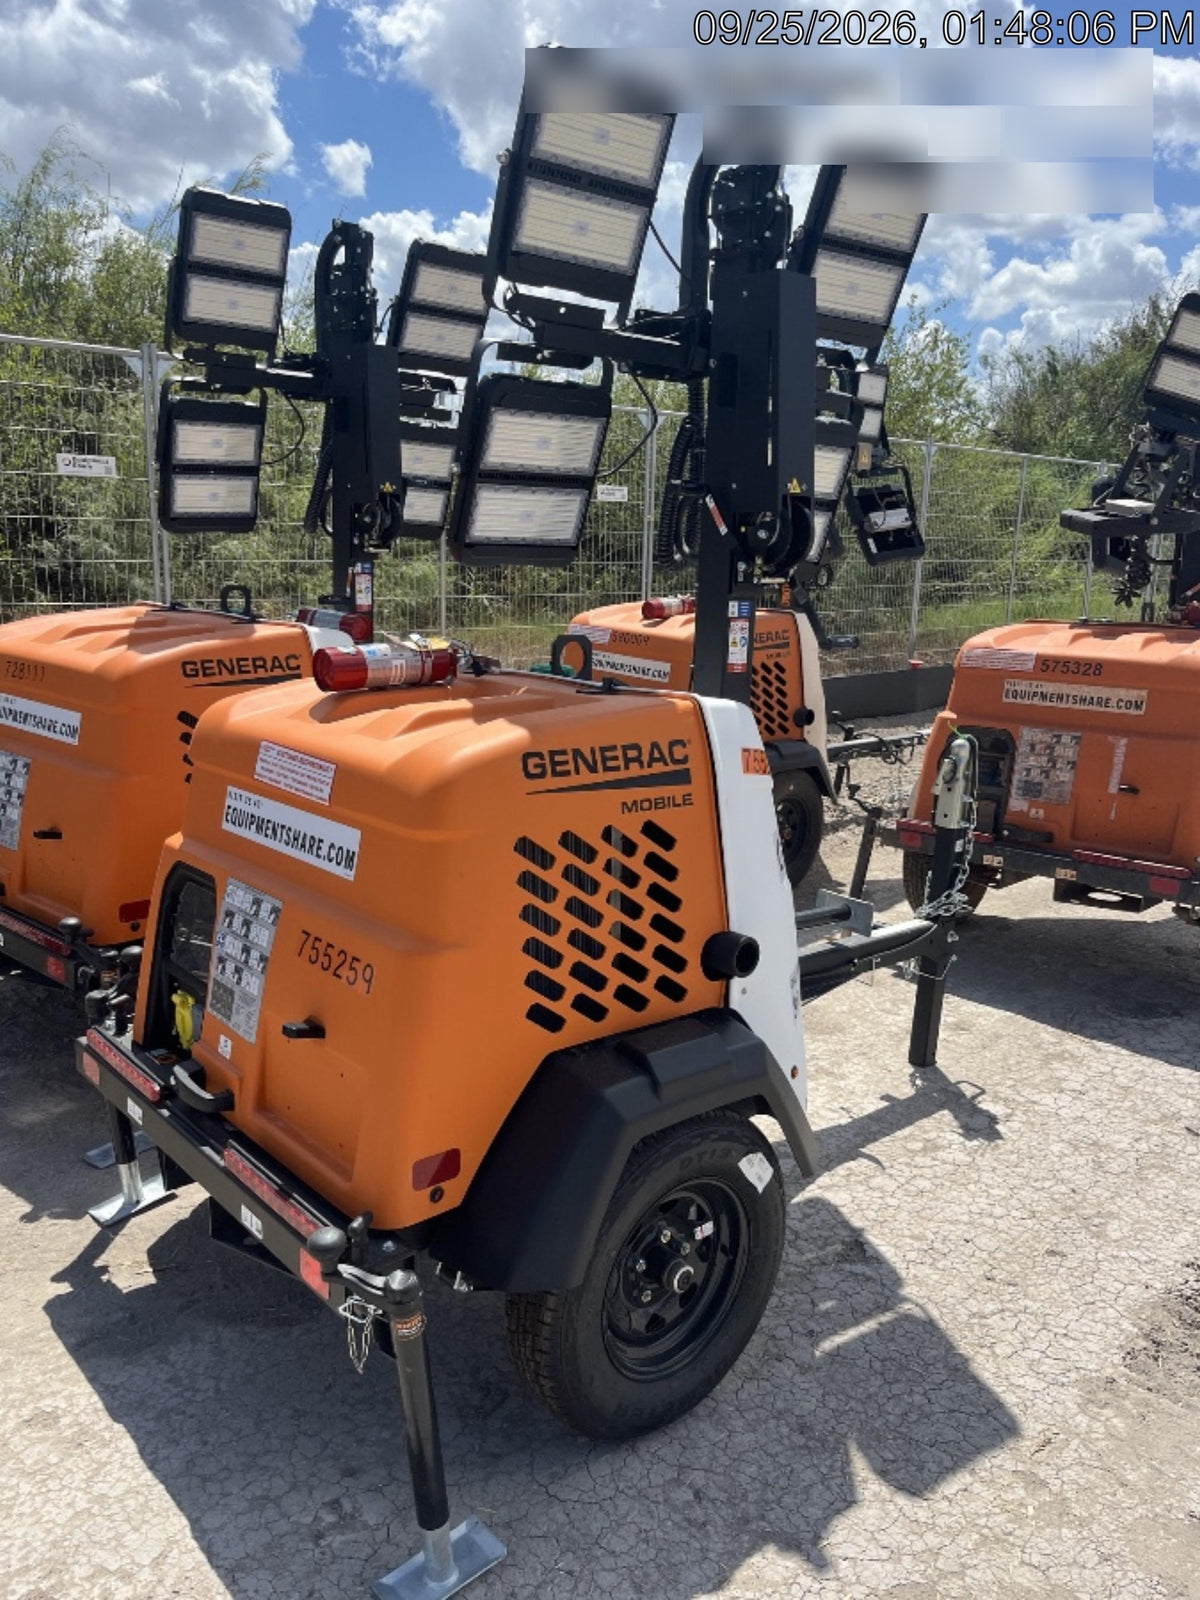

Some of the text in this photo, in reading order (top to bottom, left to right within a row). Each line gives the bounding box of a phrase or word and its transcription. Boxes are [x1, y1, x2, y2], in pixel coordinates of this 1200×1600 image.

[181, 654, 301, 678] GENERAC
[1040, 659, 1103, 677] 575328
[1004, 687, 1145, 712] EQUIPMENTSHARE.COM
[521, 739, 690, 781] GENERAC
[621, 793, 694, 815] MOBILE
[225, 805, 356, 871] EQUIPMENTSHARE.COM
[298, 929, 374, 994] 755259
